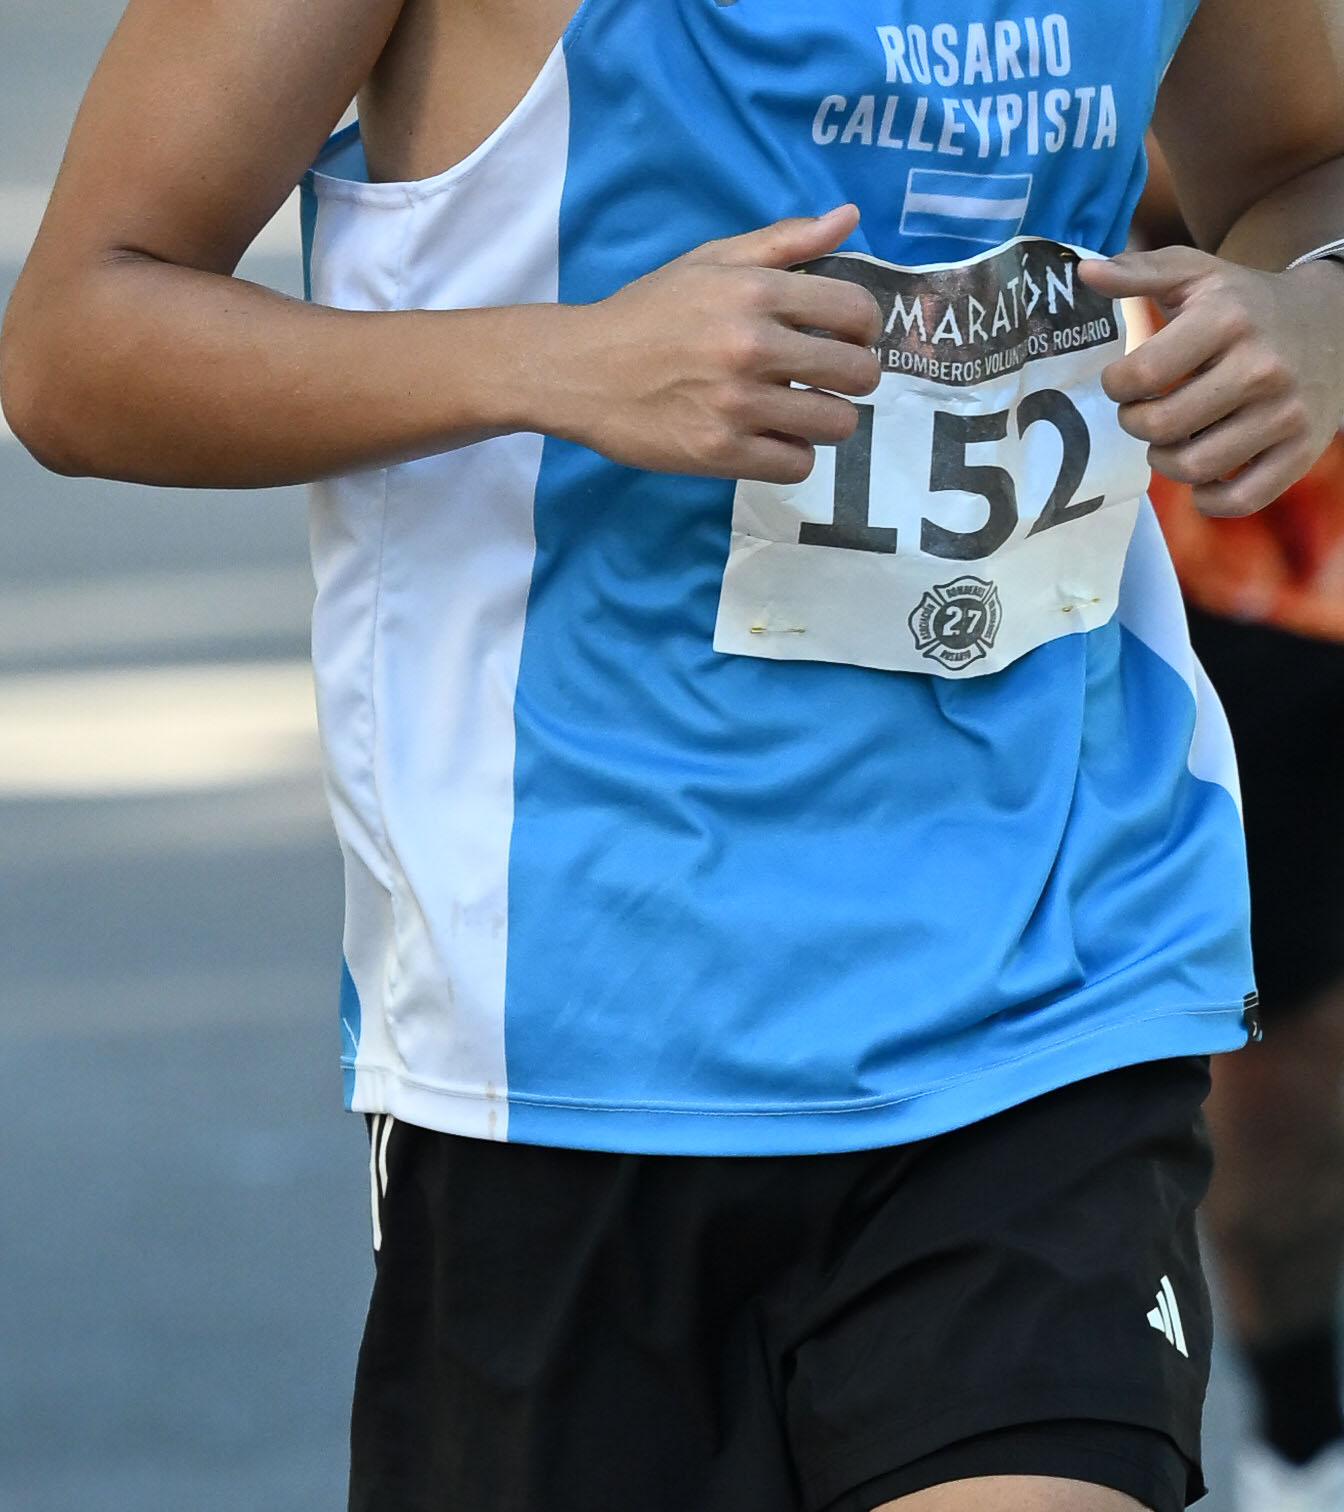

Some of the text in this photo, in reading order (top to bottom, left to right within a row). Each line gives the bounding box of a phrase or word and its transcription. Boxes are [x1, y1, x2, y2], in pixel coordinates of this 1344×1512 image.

[876, 13, 1071, 87] ROSARIO
[811, 84, 1117, 158] CALLEYPISTA
[884, 253, 1075, 347] MARATÓN
[888, 347, 981, 382] BOMBEROS
[984, 332, 1049, 376] VOLUNOS
[1053, 317, 1111, 351] ROSARIO
[798, 388, 1105, 561] 152
[942, 605, 982, 636] 27
